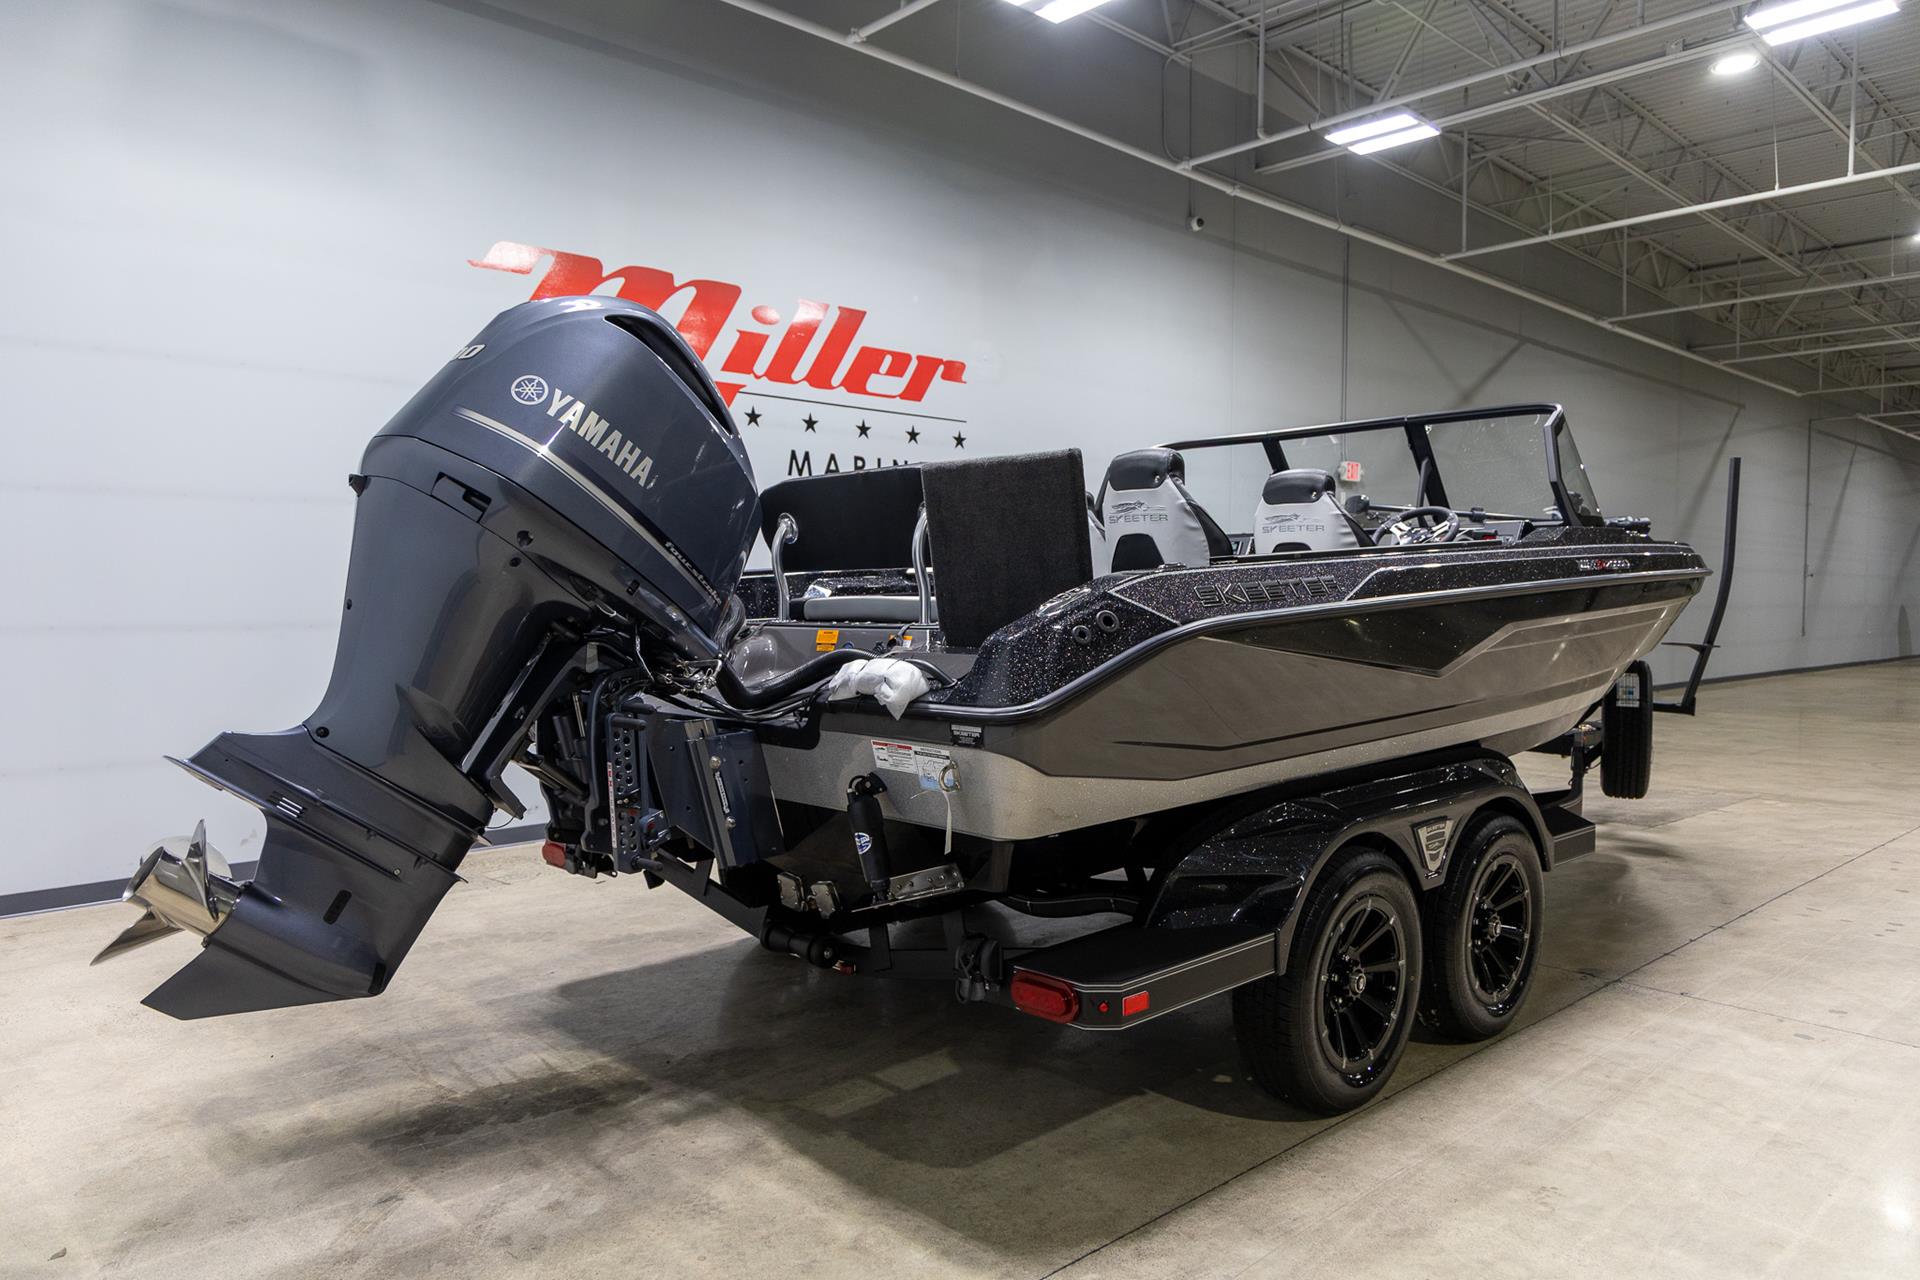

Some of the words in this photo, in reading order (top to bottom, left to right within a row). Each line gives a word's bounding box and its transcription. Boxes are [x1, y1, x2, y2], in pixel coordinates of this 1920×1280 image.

[467, 240, 967, 408] Miller
[547, 388, 653, 488] YAMAHA
[1108, 513, 1168, 525] SKEETER
[1261, 524, 1326, 534] SKEETER
[1194, 575, 1346, 607] SKEETER
